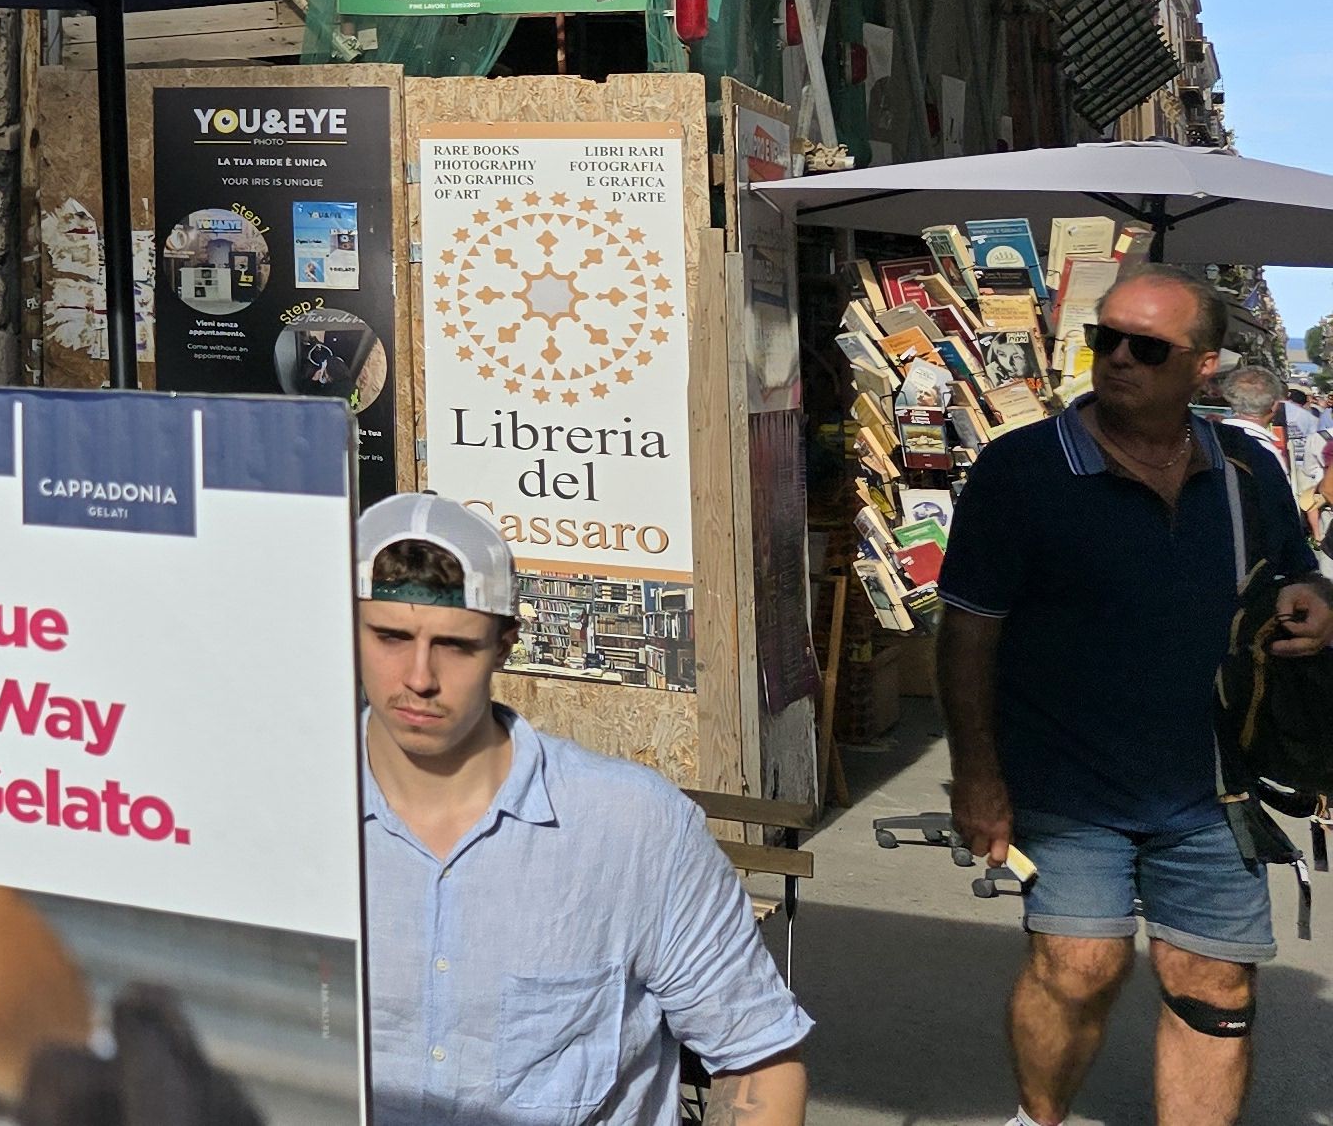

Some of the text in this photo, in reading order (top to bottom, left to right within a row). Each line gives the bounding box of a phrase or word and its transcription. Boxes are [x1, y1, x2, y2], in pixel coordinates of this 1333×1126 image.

[193, 108, 348, 135] YOU&EYE
[253, 137, 285, 146] PHOTO
[433, 145, 520, 156] RARE BOOKS
[584, 146, 665, 157] LIBRI RARI
[217, 157, 231, 166] LA
[233, 157, 254, 166] TUA
[256, 158, 283, 167] IRIDE
[294, 158, 328, 167] UNICA
[434, 159, 537, 171] PHOTOGRAPHY
[569, 161, 665, 172] FOTOGRAFIA
[221, 177, 324, 187] YOUR IRIS IS UNIQUE
[433, 175, 535, 186] AND GRAPHICS
[586, 176, 666, 188] E GRAFICA
[434, 189, 482, 200] OF ART
[315, 297, 326, 310] 2
[209, 344, 238, 352] without
[449, 407, 671, 459] Libreria
[518, 458, 601, 502] del
[38, 477, 179, 505] CAPPADONIA
[87, 505, 129, 520] GELATI
